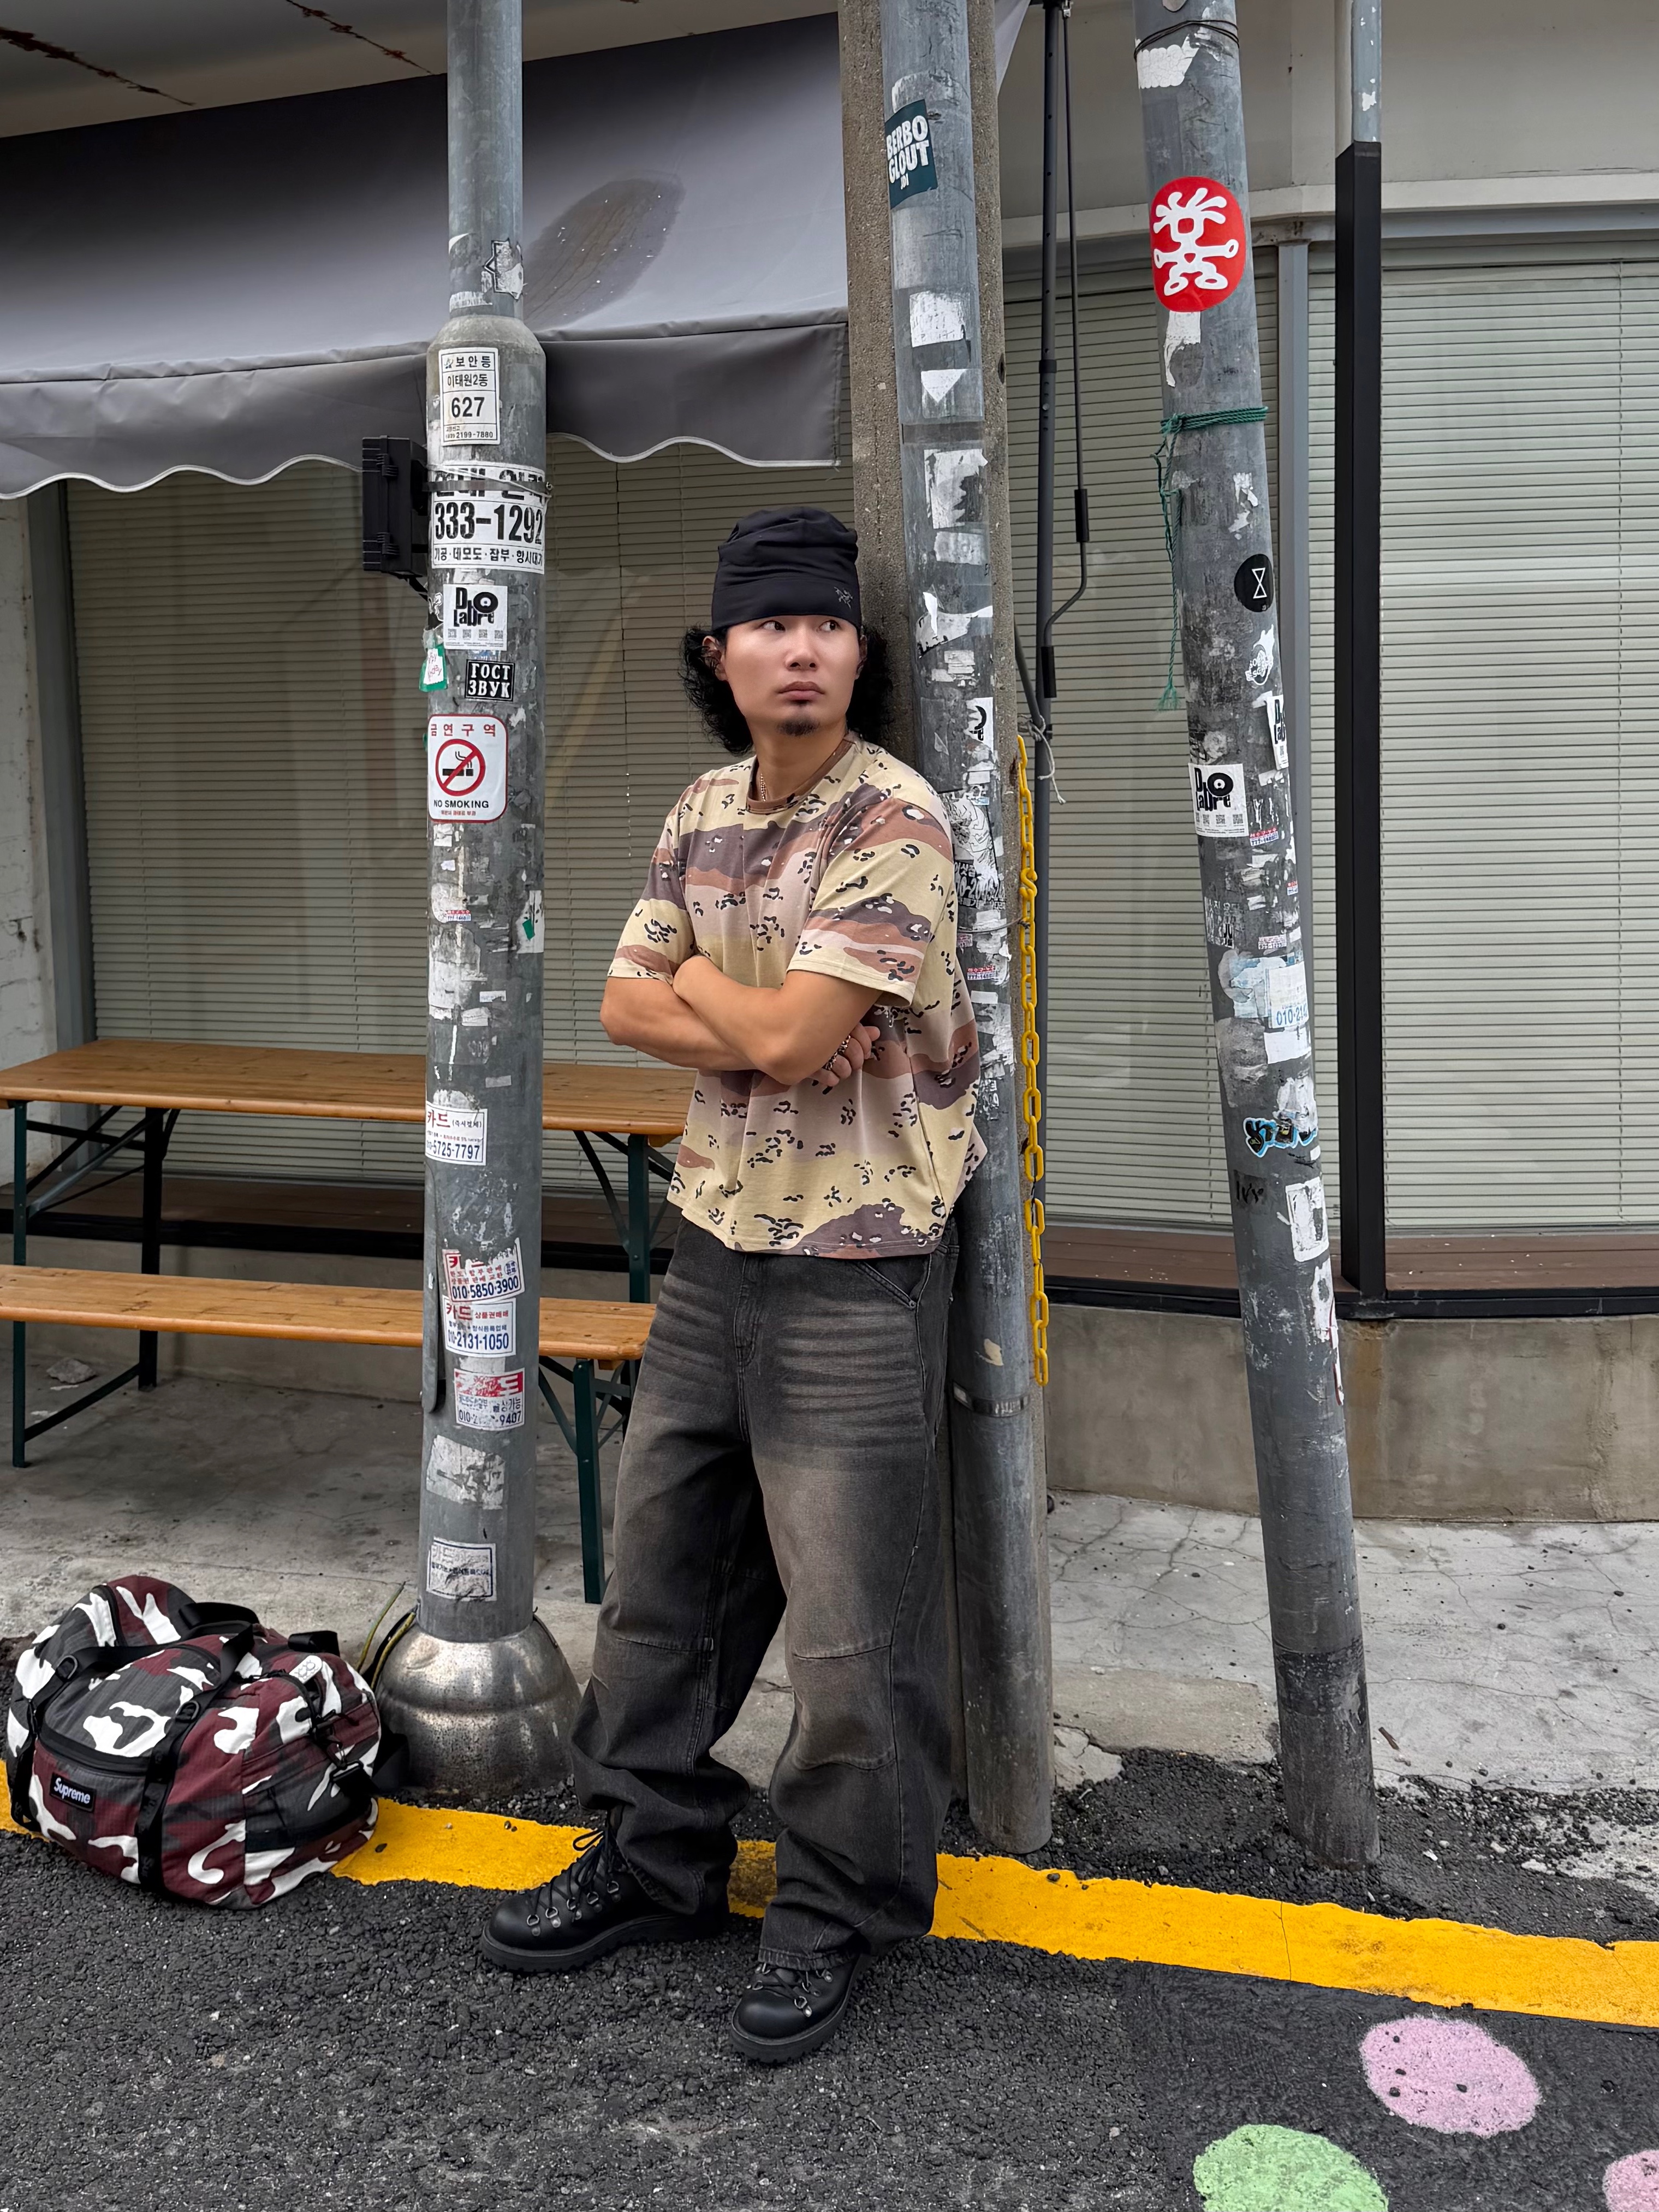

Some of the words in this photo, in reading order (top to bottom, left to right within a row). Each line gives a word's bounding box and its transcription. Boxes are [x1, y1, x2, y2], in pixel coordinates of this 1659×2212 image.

[889, 140, 930, 183] GLOUT
[448, 373, 488, 388] 이태원2동
[451, 396, 485, 418] 627
[435, 502, 543, 545] 333-1292
[471, 663, 511, 680] ГОСТ
[468, 679, 510, 698] ЗВУК
[433, 799, 443, 808] NO
[444, 799, 489, 809] SMOKING
[427, 1109, 450, 1128] 카드
[446, 1303, 473, 1320] 카드
[53, 1777, 91, 1804] Supreme
